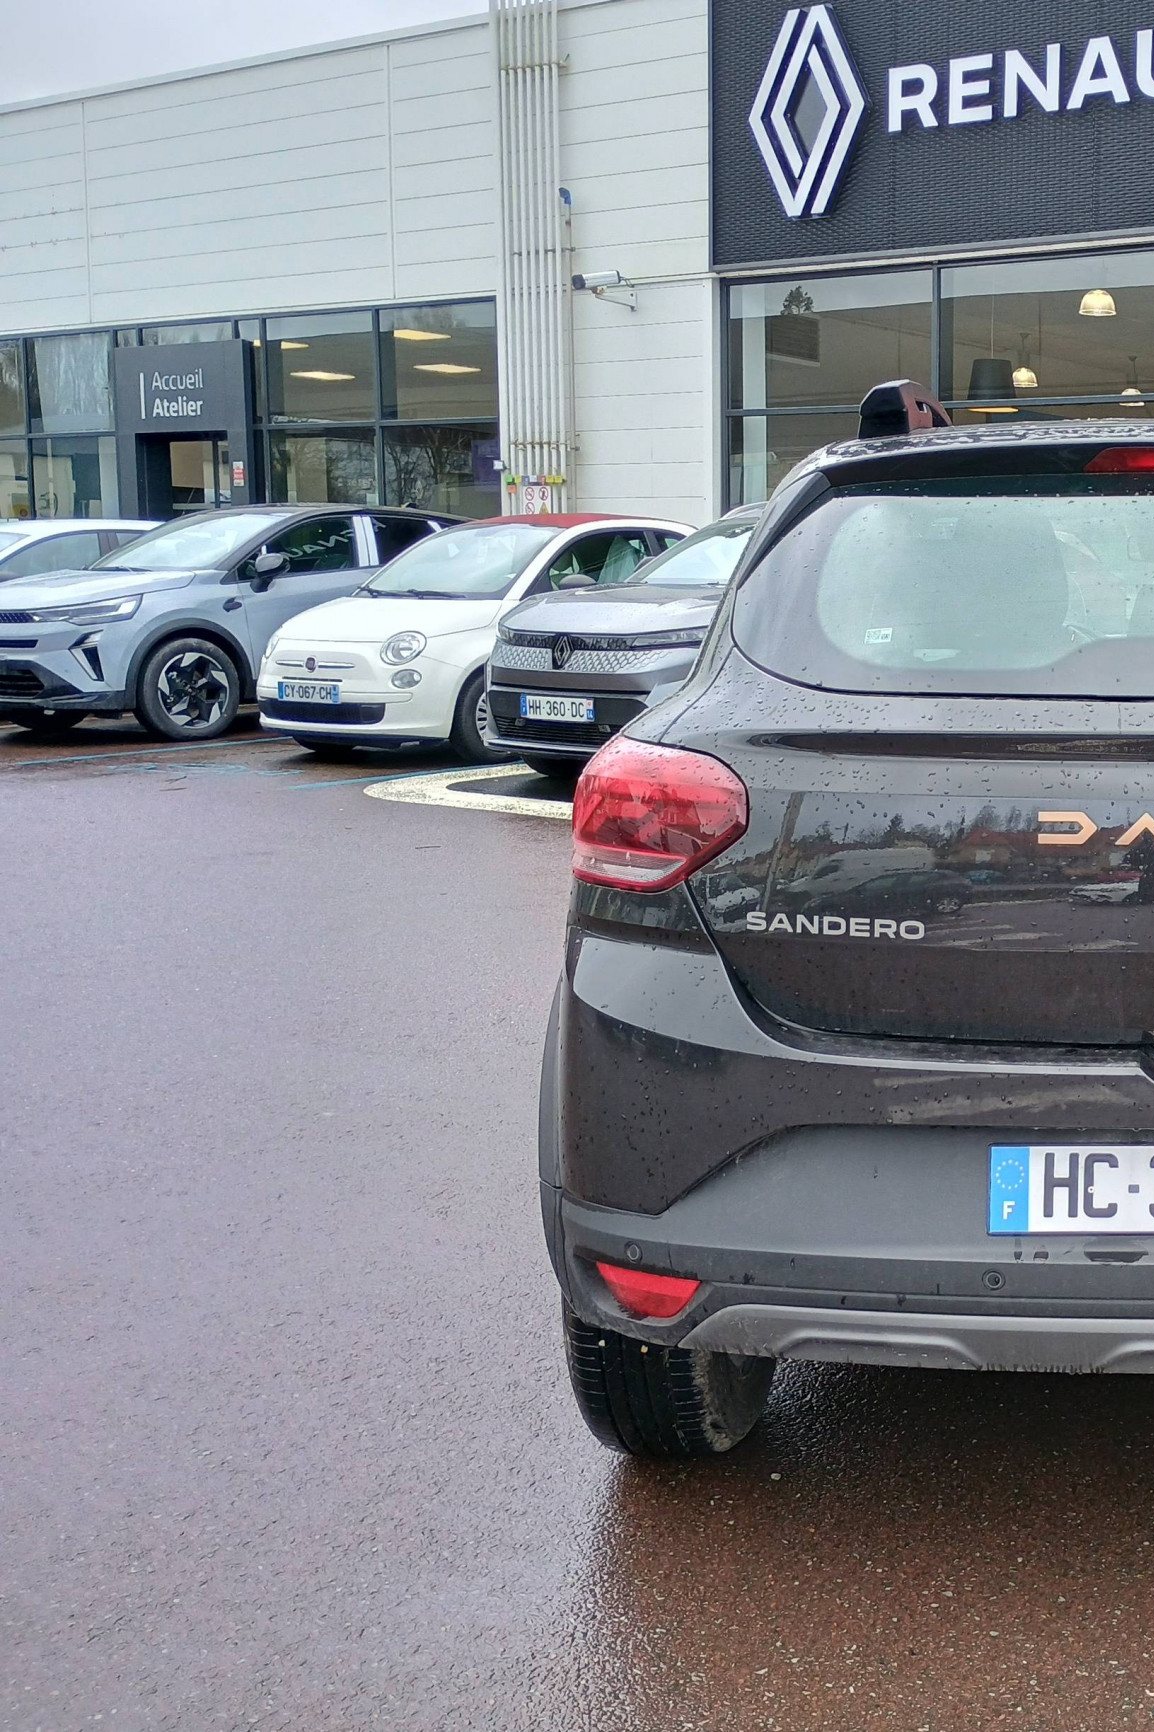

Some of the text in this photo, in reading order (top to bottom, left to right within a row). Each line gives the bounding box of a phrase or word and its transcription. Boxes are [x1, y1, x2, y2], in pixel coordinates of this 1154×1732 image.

[151, 368, 204, 391] Accueil
[152, 395, 204, 418] Atelier
[283, 684, 332, 701] CY-067-CH
[528, 699, 585, 718] HH-360-DC
[746, 911, 925, 940] SANDERO
[1003, 1201, 1016, 1220] F
